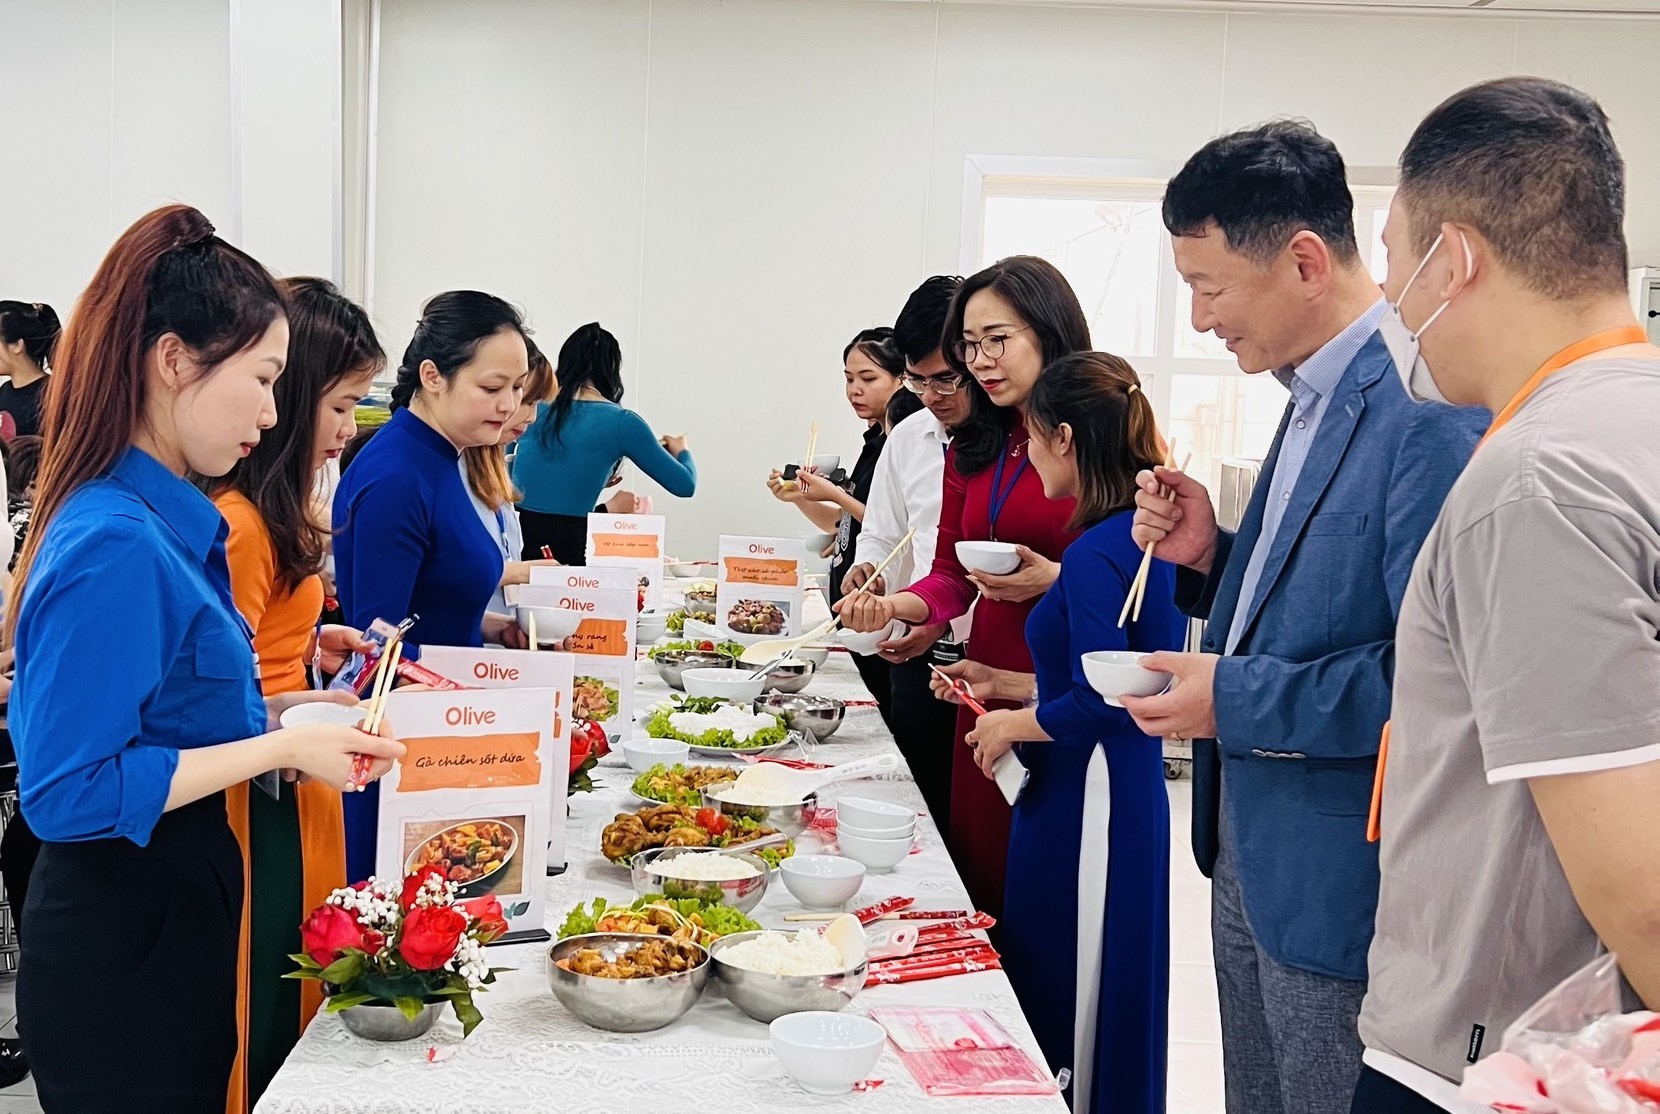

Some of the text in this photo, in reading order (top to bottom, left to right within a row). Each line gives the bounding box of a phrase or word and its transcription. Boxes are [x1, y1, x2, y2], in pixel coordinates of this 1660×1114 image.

[614, 520, 638, 530] Olive
[749, 544, 775, 555] Olive
[567, 576, 600, 589] Olive
[559, 597, 595, 612] Olive
[473, 662, 520, 681] Olive
[445, 706, 496, 726] Olive
[415, 752, 526, 768] Gà chiên sốt dứa
